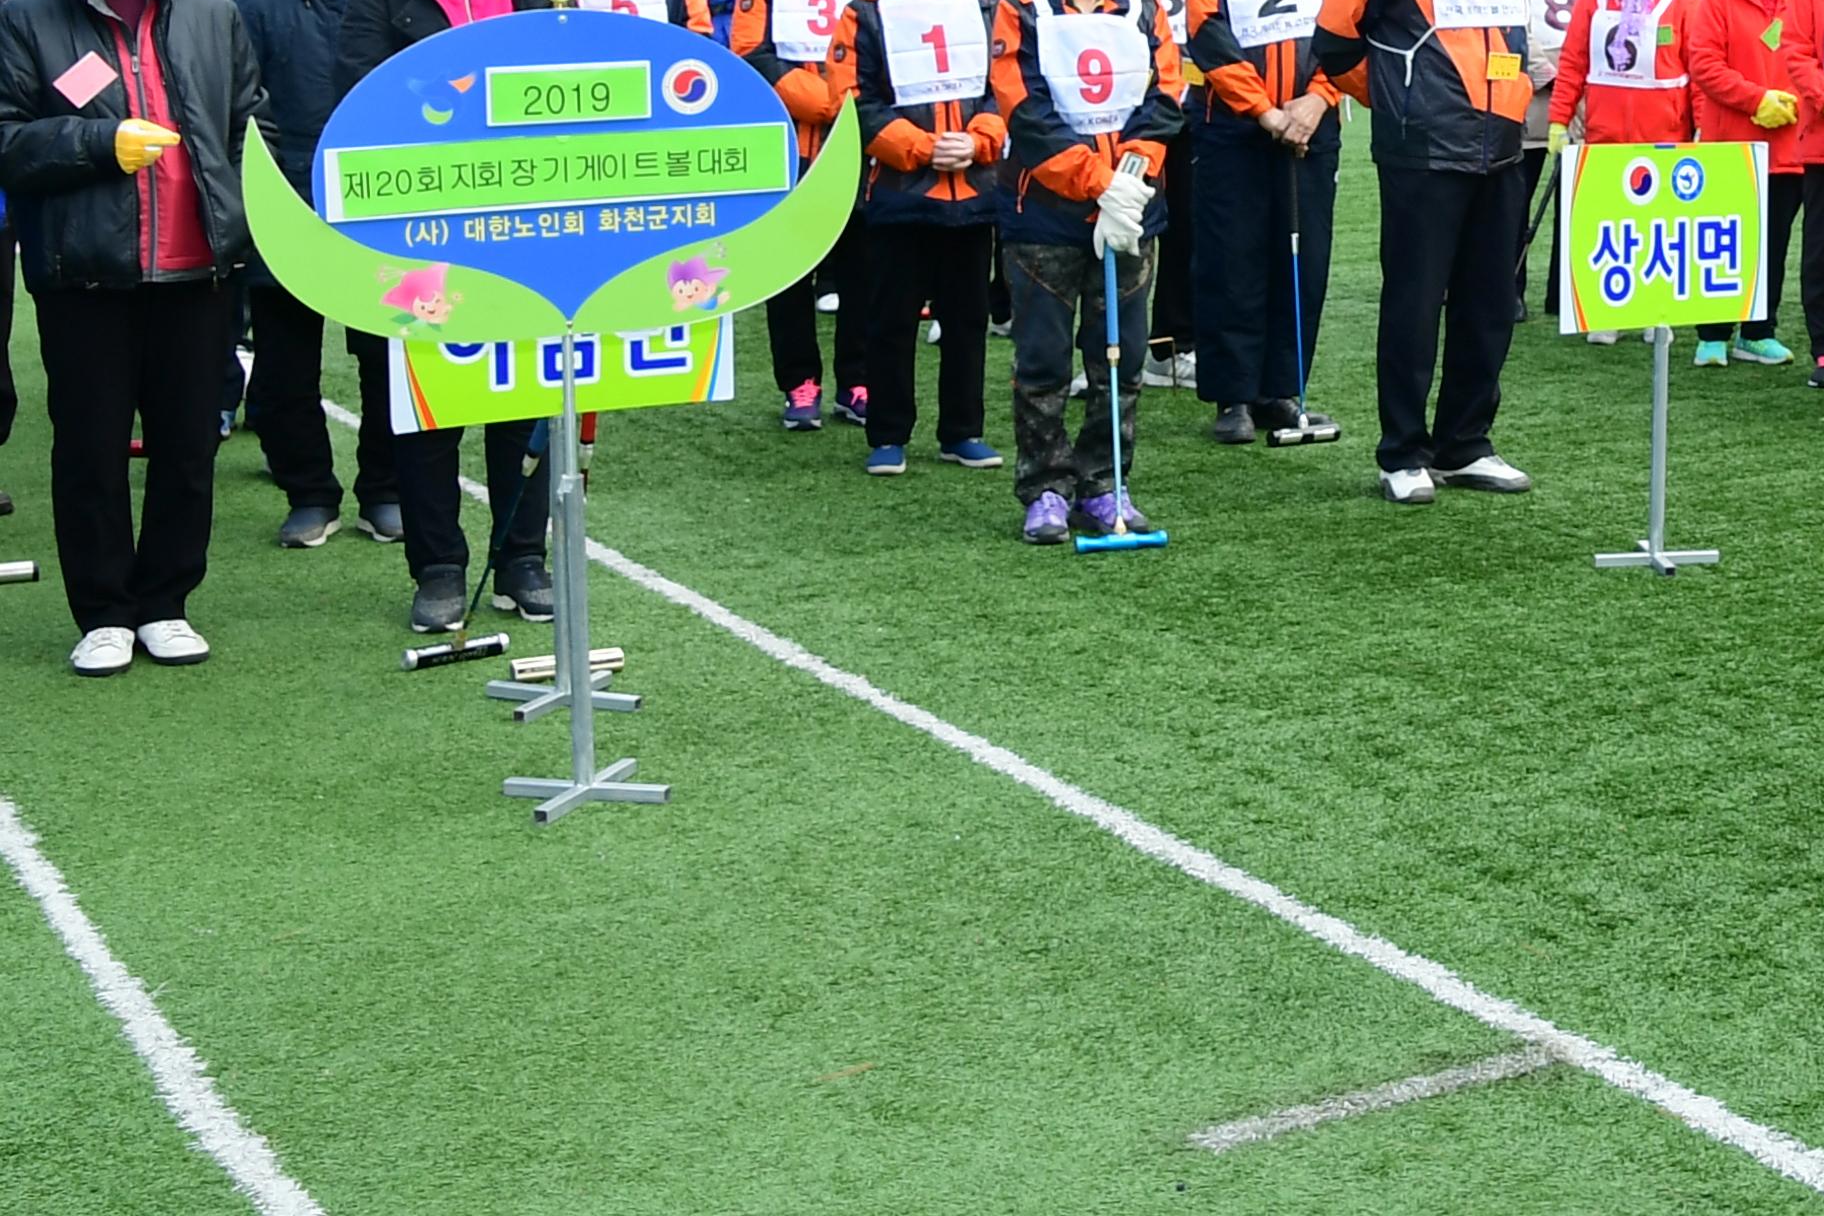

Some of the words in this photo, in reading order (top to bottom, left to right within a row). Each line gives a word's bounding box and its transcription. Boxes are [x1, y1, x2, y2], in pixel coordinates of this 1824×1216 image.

[921, 25, 950, 73] 1
[523, 82, 611, 117] 2019
[1076, 48, 1114, 104] 9
[404, 221, 450, 248] (사)
[464, 211, 584, 243] 대한노인회
[598, 201, 717, 234] 화천군지회
[1591, 218, 1740, 302] 상서면
